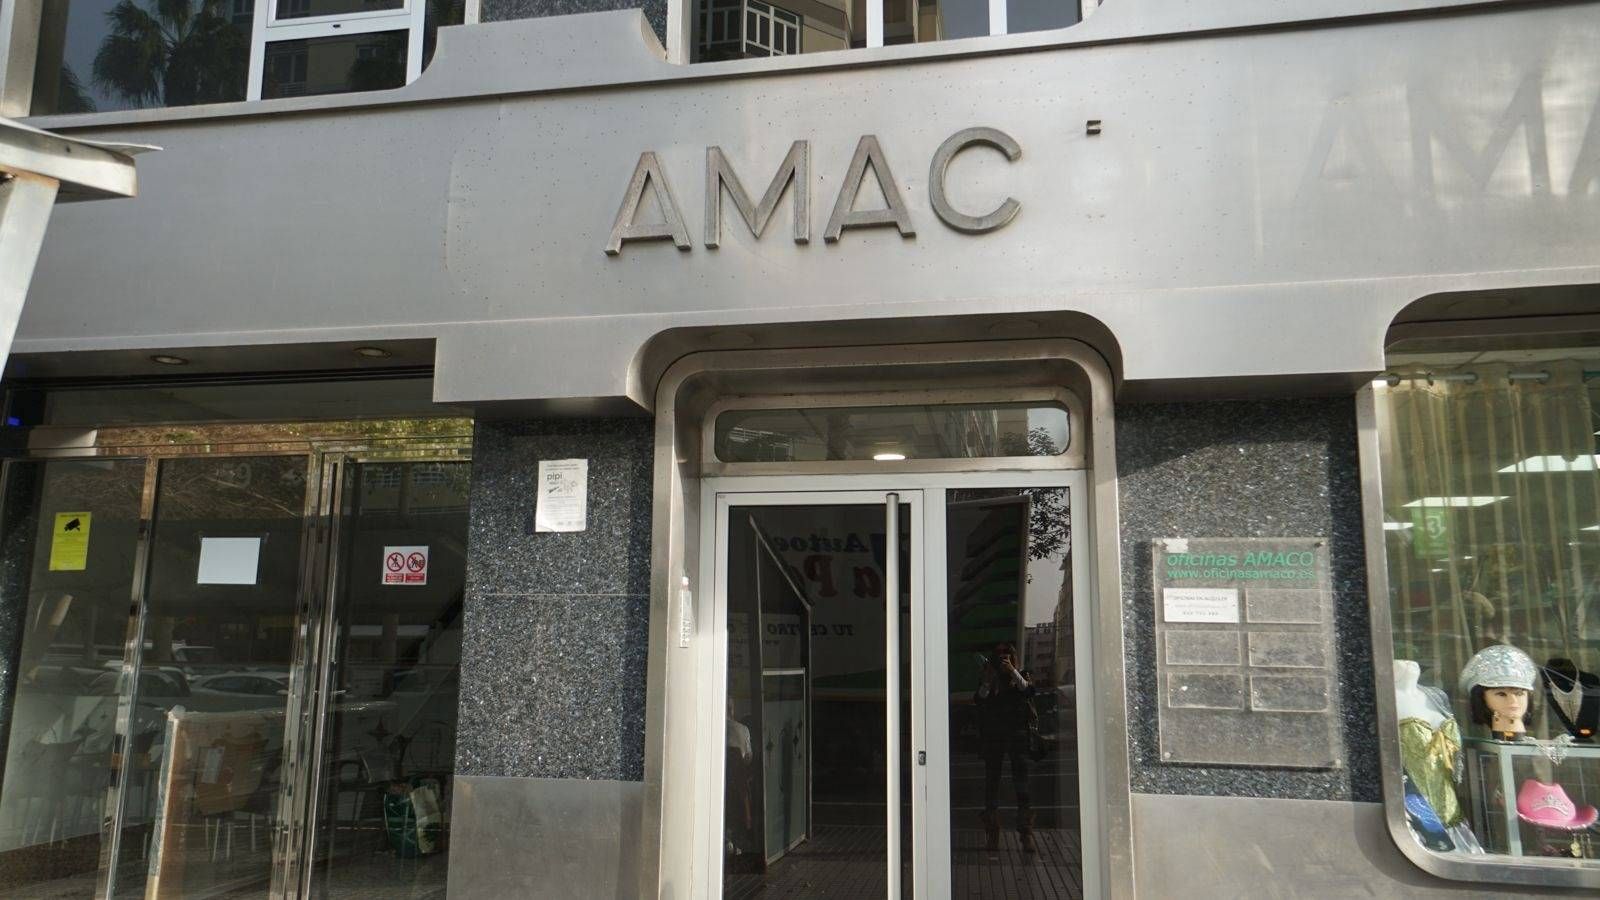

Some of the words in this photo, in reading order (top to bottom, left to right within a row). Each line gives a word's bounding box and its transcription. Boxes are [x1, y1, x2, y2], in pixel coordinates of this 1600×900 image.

[603, 126, 1022, 256] AMAC
[1167, 552, 1238, 566] oficinas
[1243, 551, 1314, 567] AMACO
[1167, 567, 1314, 580] www.oficinasamaco.es
